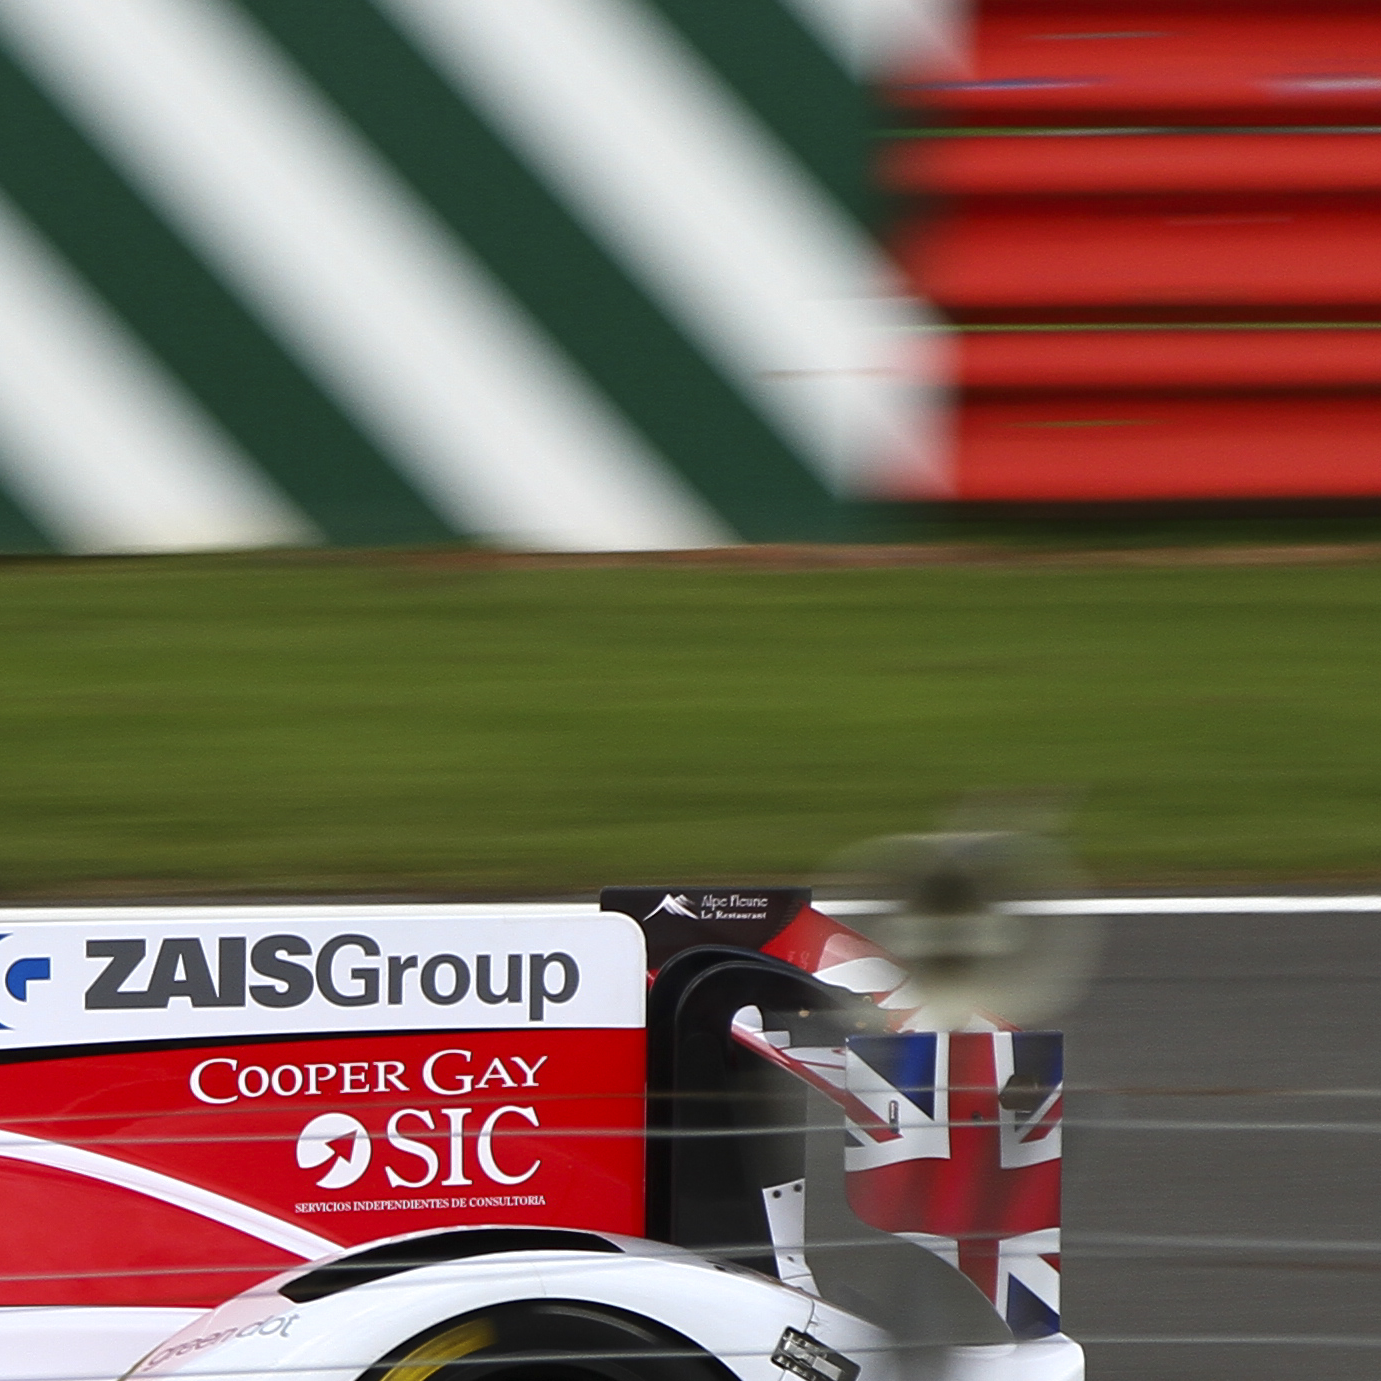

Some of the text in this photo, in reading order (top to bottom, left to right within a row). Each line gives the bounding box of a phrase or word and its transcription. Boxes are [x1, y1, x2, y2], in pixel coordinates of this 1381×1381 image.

[84, 933, 580, 1022] ZAISGroup
[385, 1105, 541, 1188] SIC
[295, 1201, 352, 1214] SERVICIOS
[353, 1198, 449, 1211] INDEPENDIENTES
[451, 1197, 467, 1208] DE
